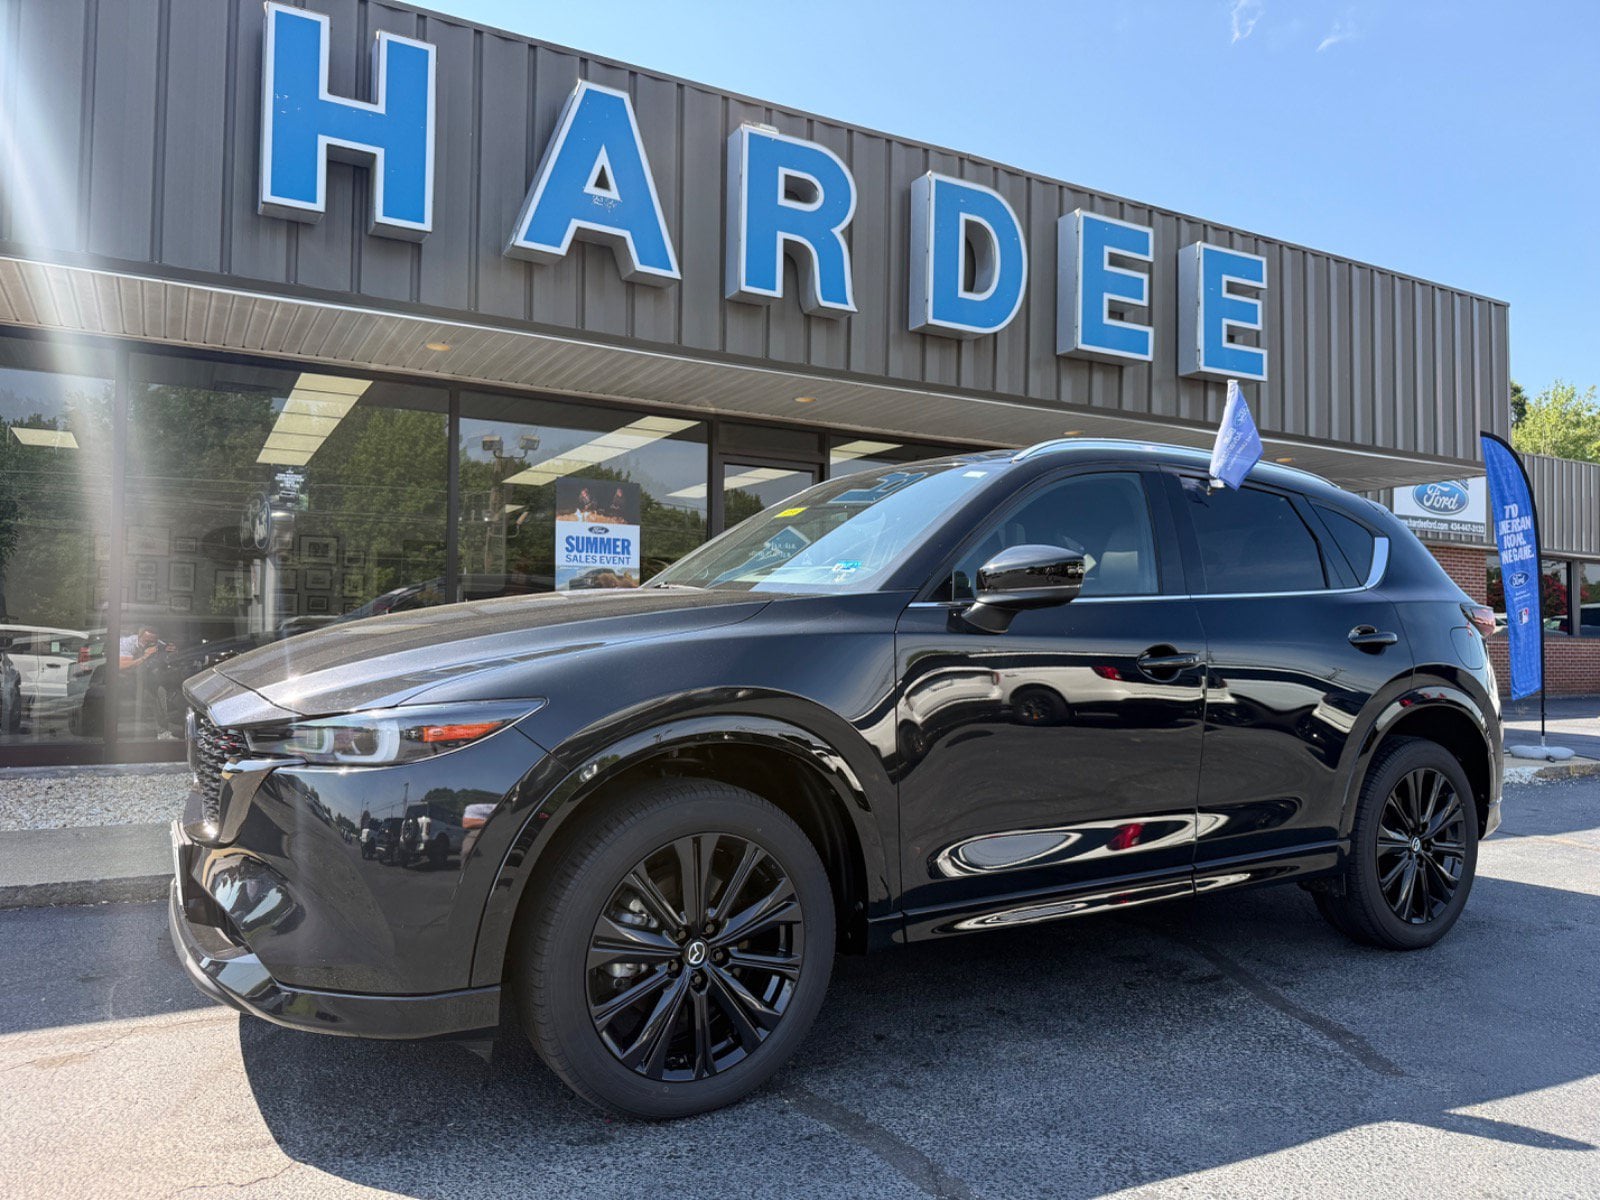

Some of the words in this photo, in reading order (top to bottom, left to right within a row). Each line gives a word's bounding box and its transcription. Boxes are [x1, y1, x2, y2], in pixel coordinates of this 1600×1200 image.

[259, 1, 1268, 382] HARDEE
[1423, 482, 1459, 510] Ford
[565, 535, 631, 555] SUMMER
[565, 554, 598, 564] SALES
[599, 555, 631, 565] EVENT
